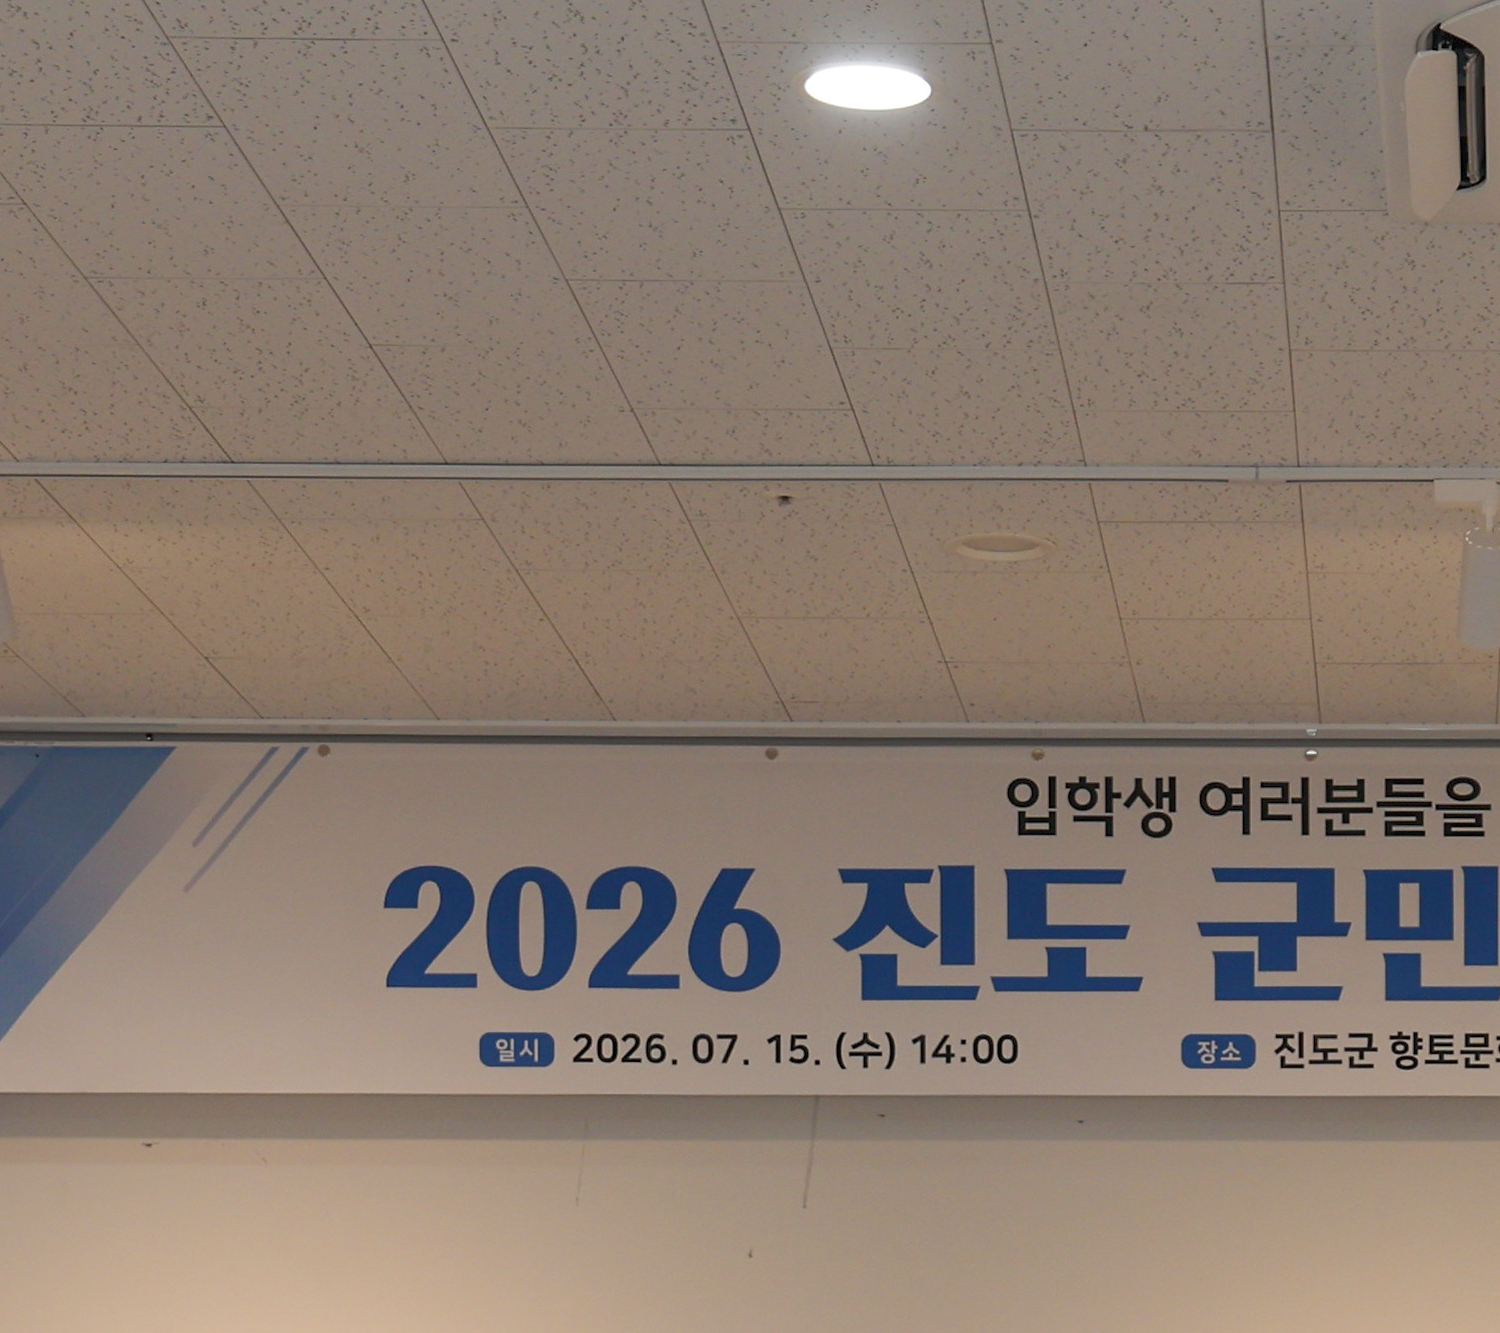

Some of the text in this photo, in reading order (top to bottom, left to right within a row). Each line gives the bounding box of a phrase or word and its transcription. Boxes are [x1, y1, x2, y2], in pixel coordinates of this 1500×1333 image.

[1006, 775, 1178, 839] 입학생
[1199, 775, 1492, 838] 여러분들을
[383, 864, 782, 993] 2026
[831, 864, 1144, 1001] 진도
[494, 1031, 1020, 1070] 일시 2026. 07. 15. (수) 14:00
[1196, 1039, 1243, 1063] 장소
[1274, 1031, 1379, 1070] 진도군
